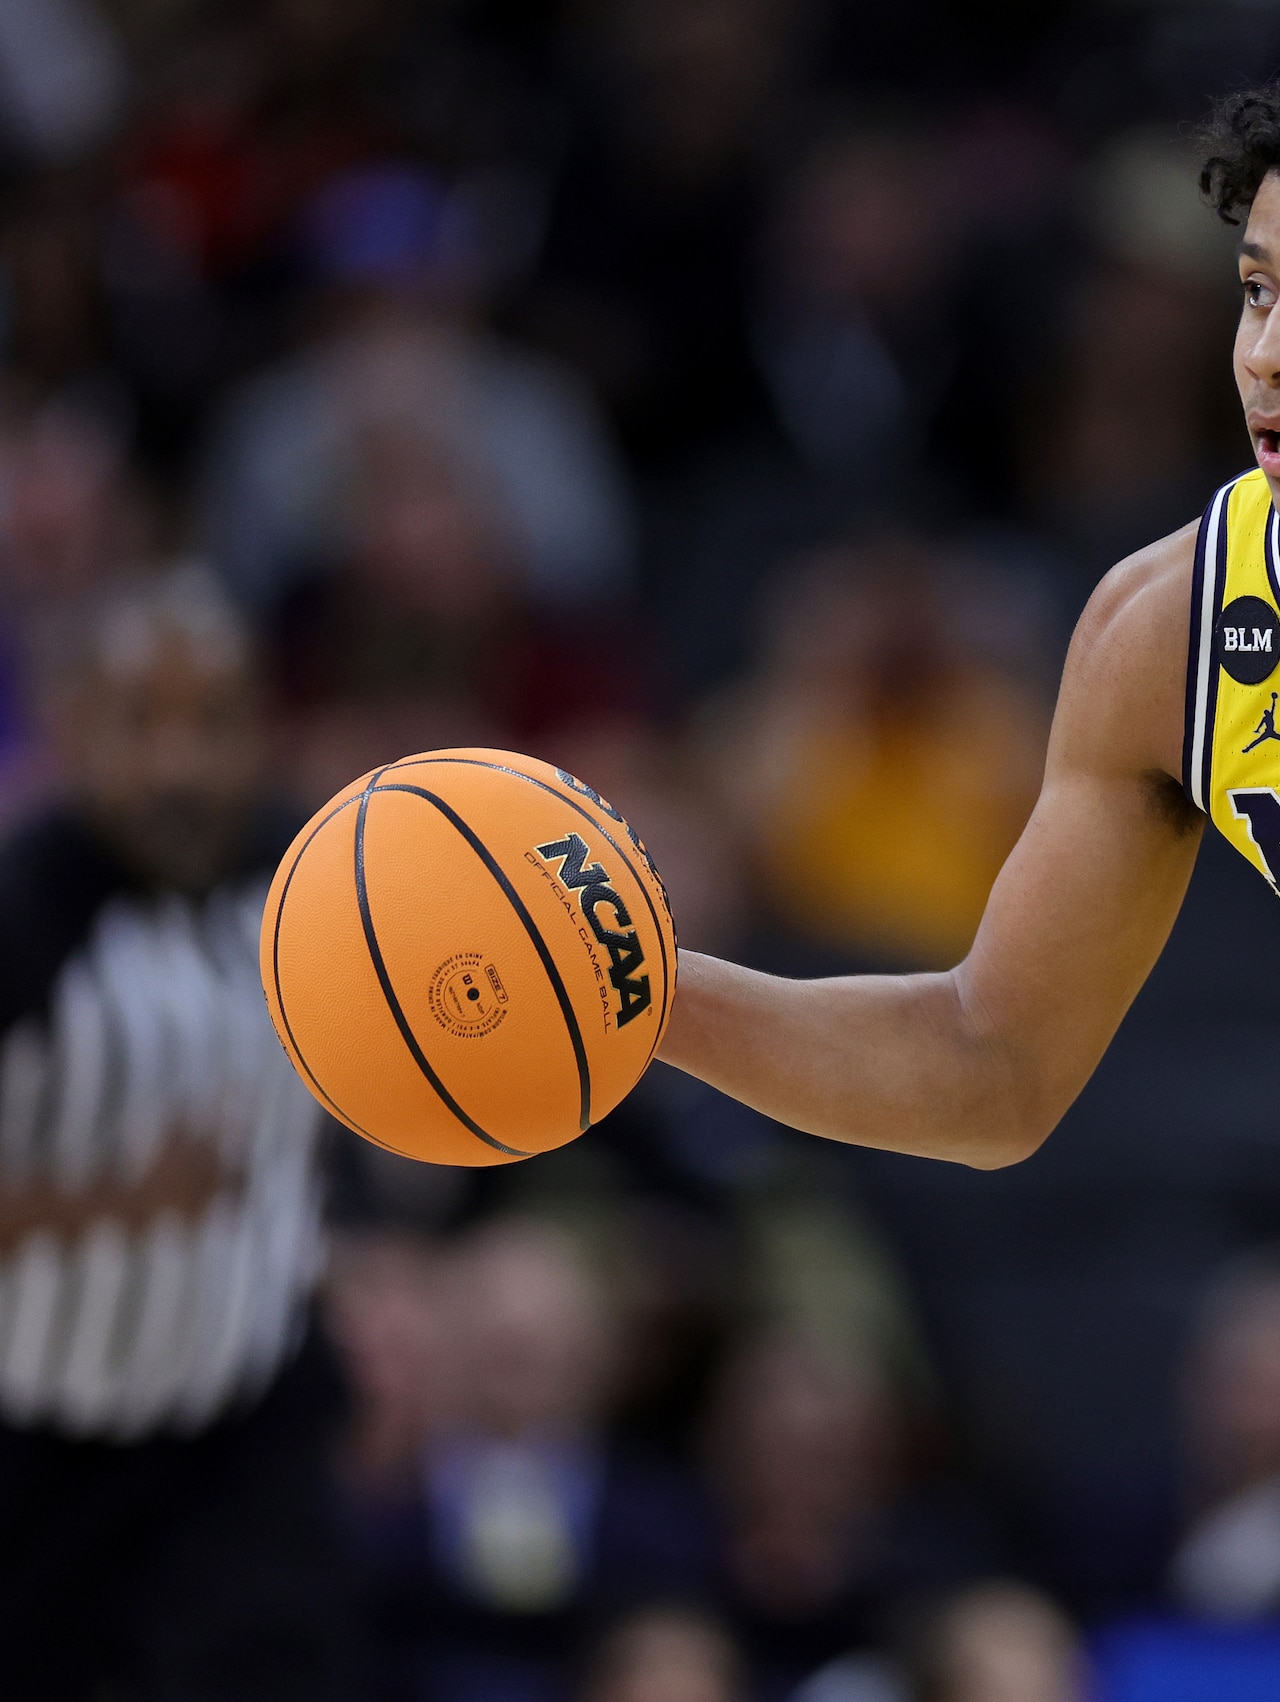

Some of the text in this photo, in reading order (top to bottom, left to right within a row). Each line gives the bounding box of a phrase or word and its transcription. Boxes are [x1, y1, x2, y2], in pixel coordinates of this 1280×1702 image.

[1223, 626, 1273, 653] BLM
[488, 968, 501, 992] SIZE
[524, 851, 611, 1035] OFFICIAL GAME BALL
[533, 832, 652, 1032] NCAA
